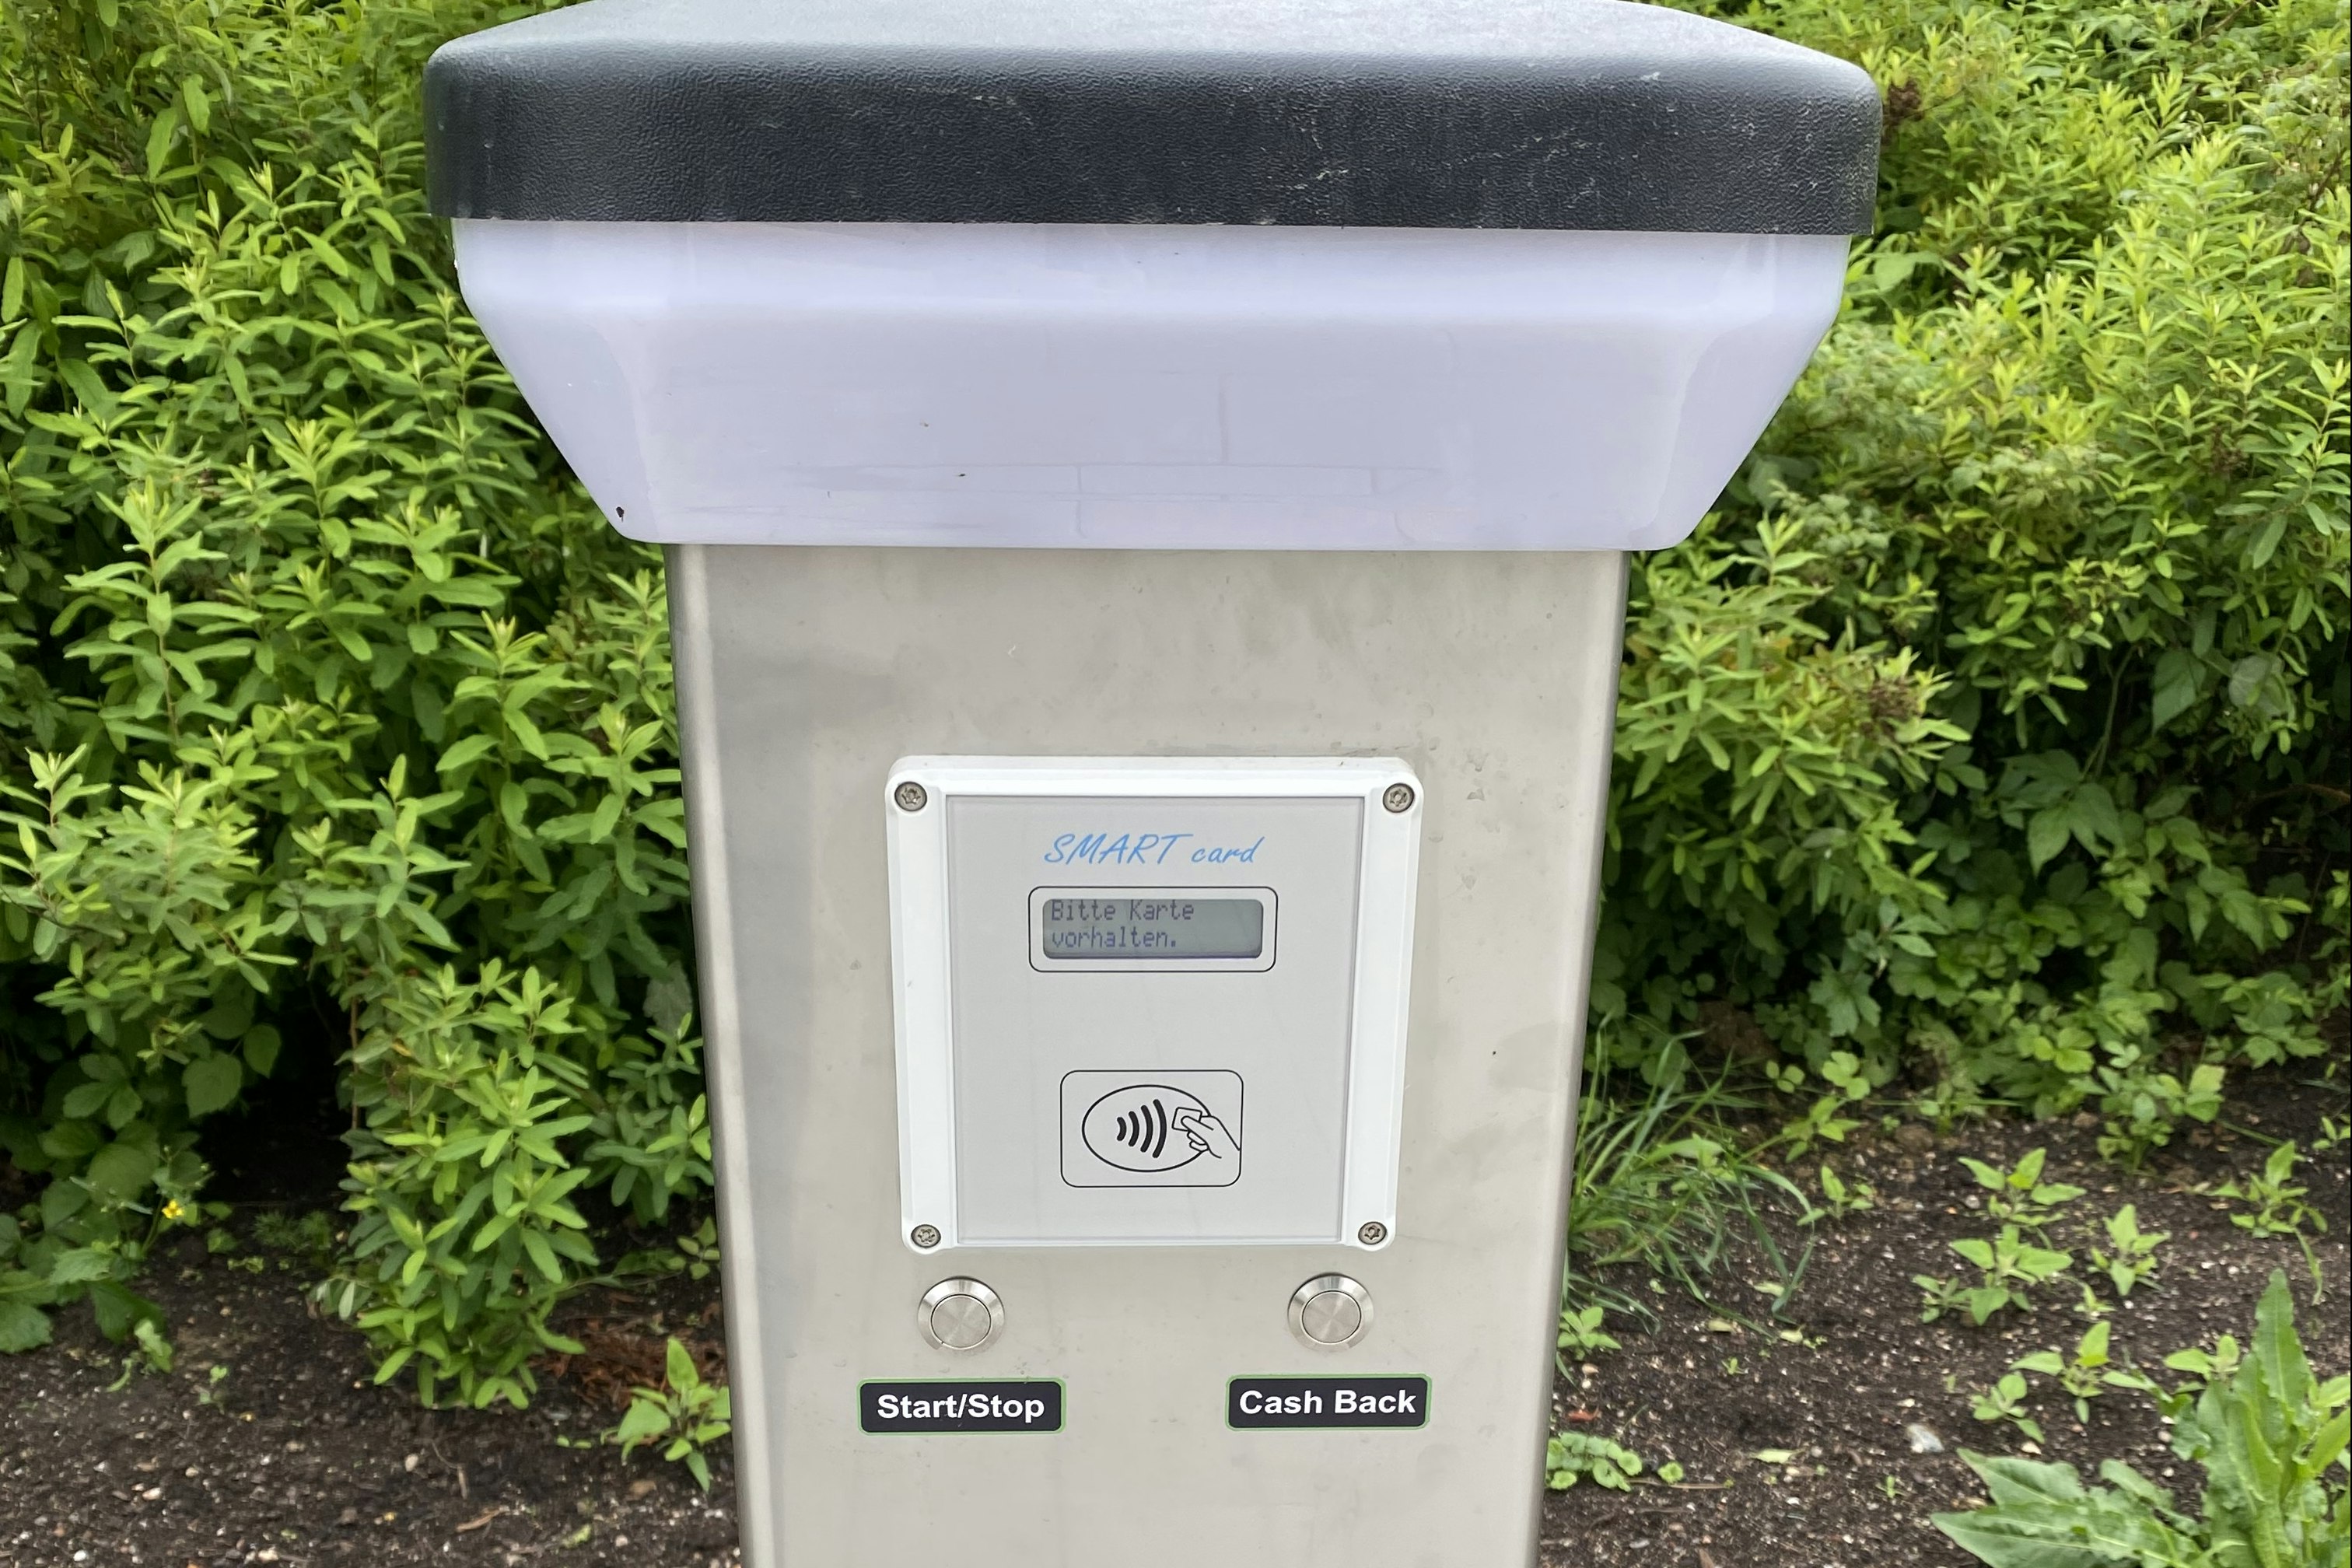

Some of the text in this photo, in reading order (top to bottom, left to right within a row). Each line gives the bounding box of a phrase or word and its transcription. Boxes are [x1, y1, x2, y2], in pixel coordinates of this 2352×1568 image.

[1044, 834, 1265, 865] SMART card
[1051, 899, 1195, 921] Bitte Karte
[1052, 926, 1177, 948] vorhalten.
[877, 1392, 1045, 1424] Start/Stop
[1239, 1388, 1417, 1415] Cash Back
